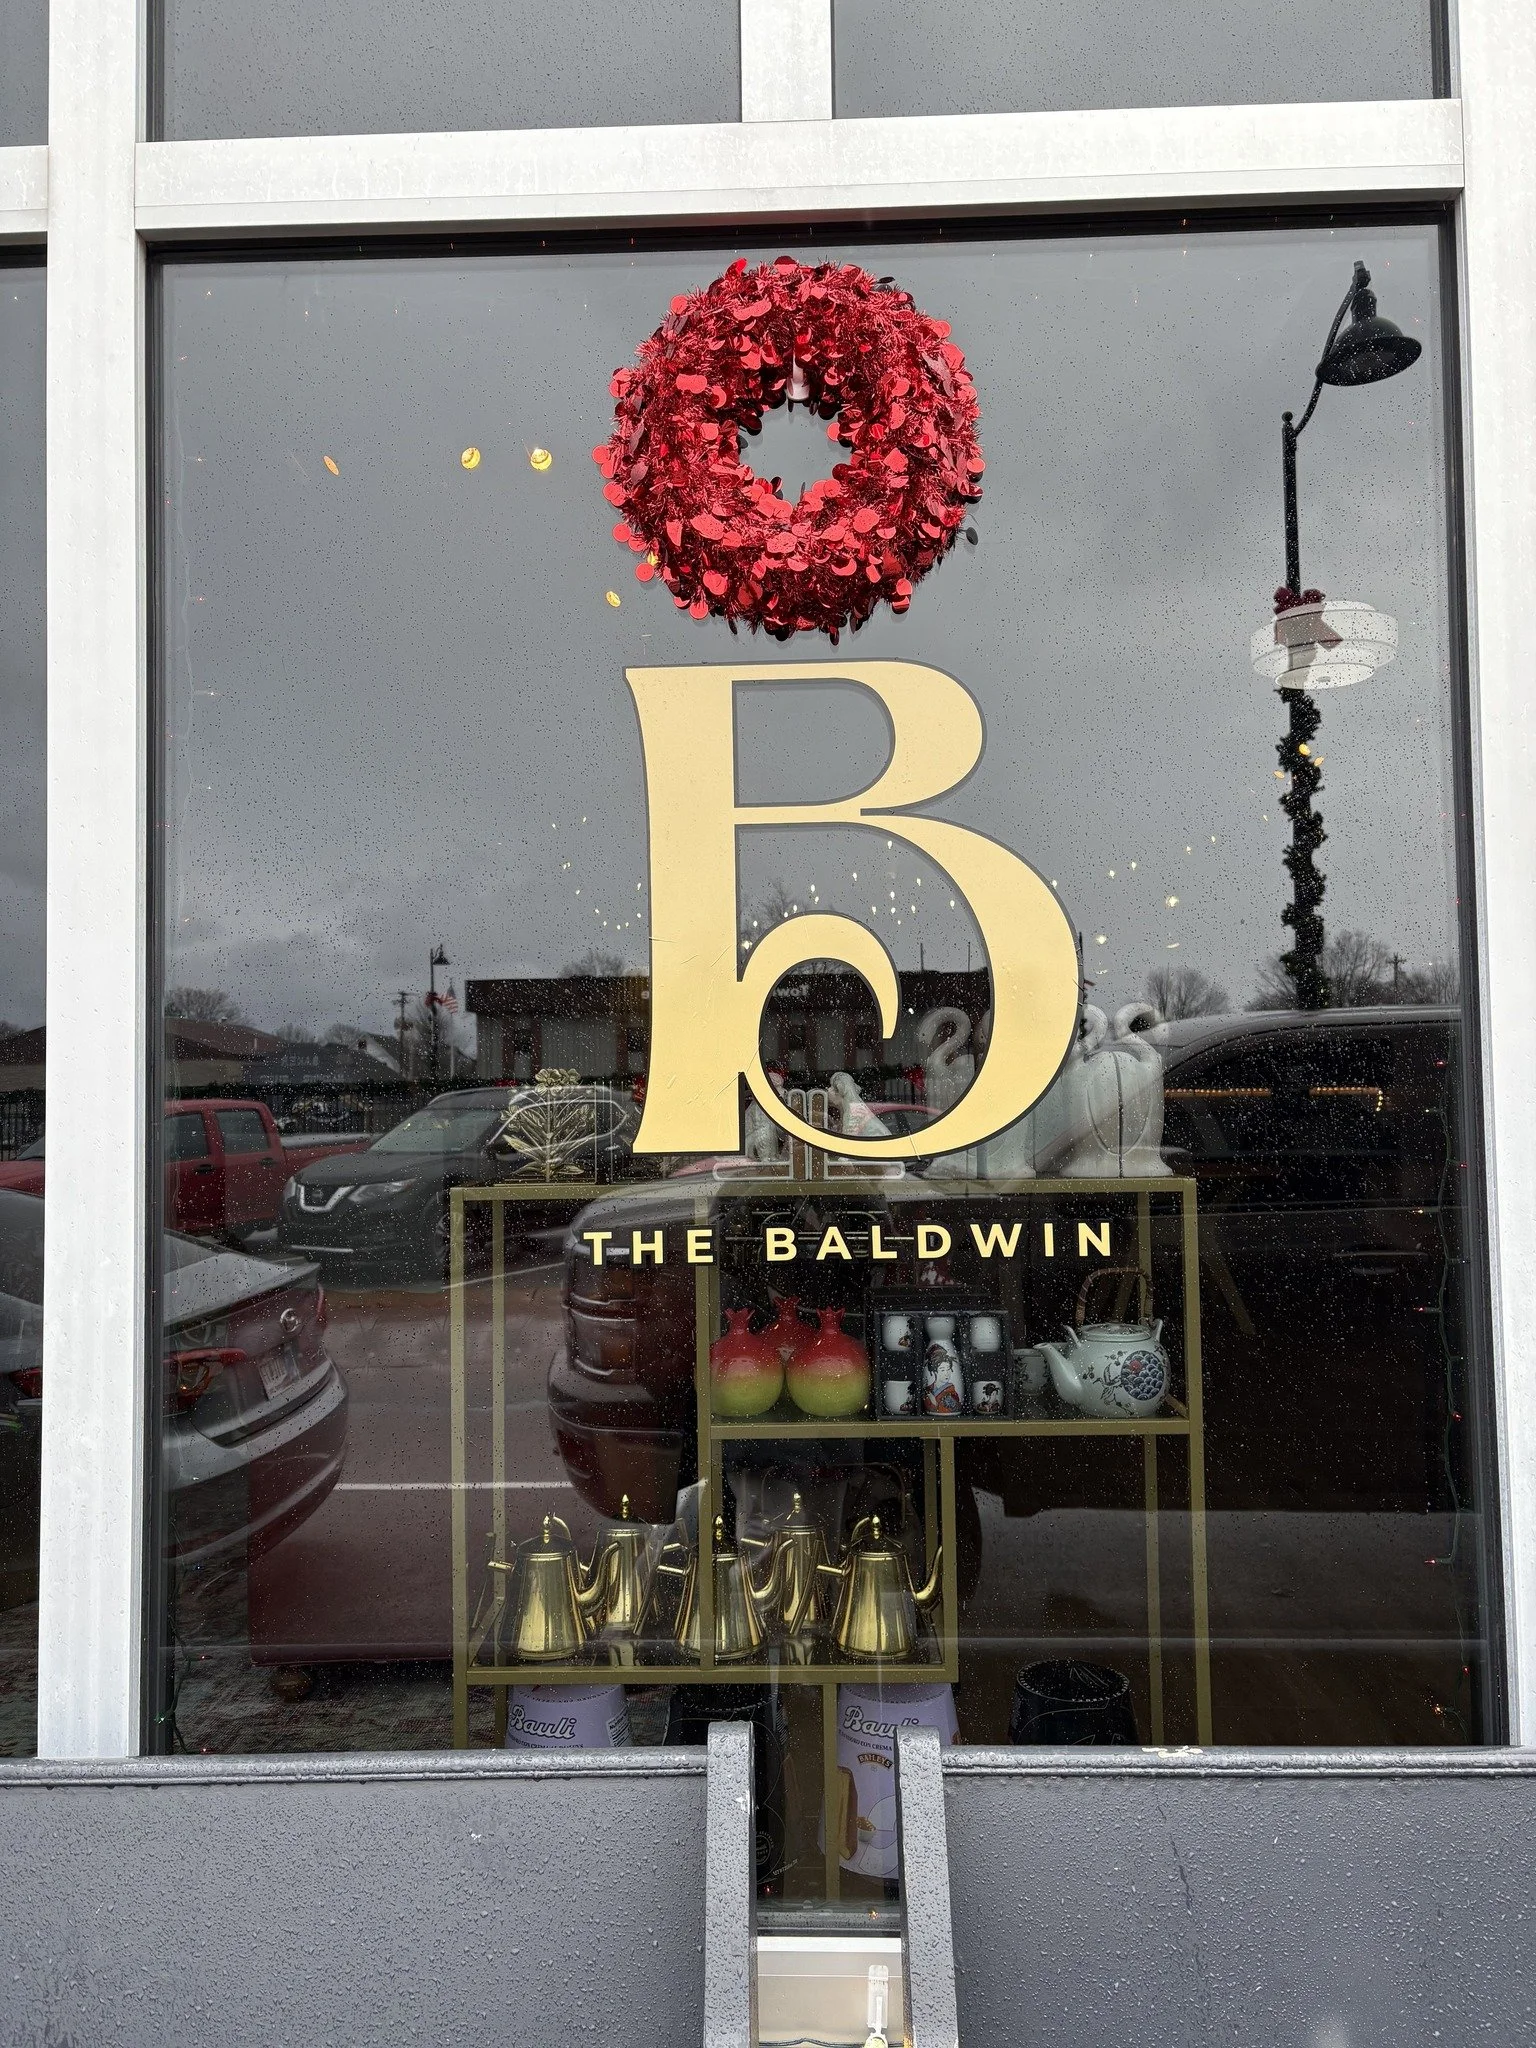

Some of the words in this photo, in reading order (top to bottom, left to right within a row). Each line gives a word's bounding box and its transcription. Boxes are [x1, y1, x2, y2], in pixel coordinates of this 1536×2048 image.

[626, 661, 1080, 1159] B
[583, 1229, 713, 1265] THE
[766, 1222, 1111, 1261] BALDWIN
[510, 1705, 577, 1740] Bauli
[843, 1705, 920, 1739] Bau
[859, 1754, 892, 1768] BAILEYS
